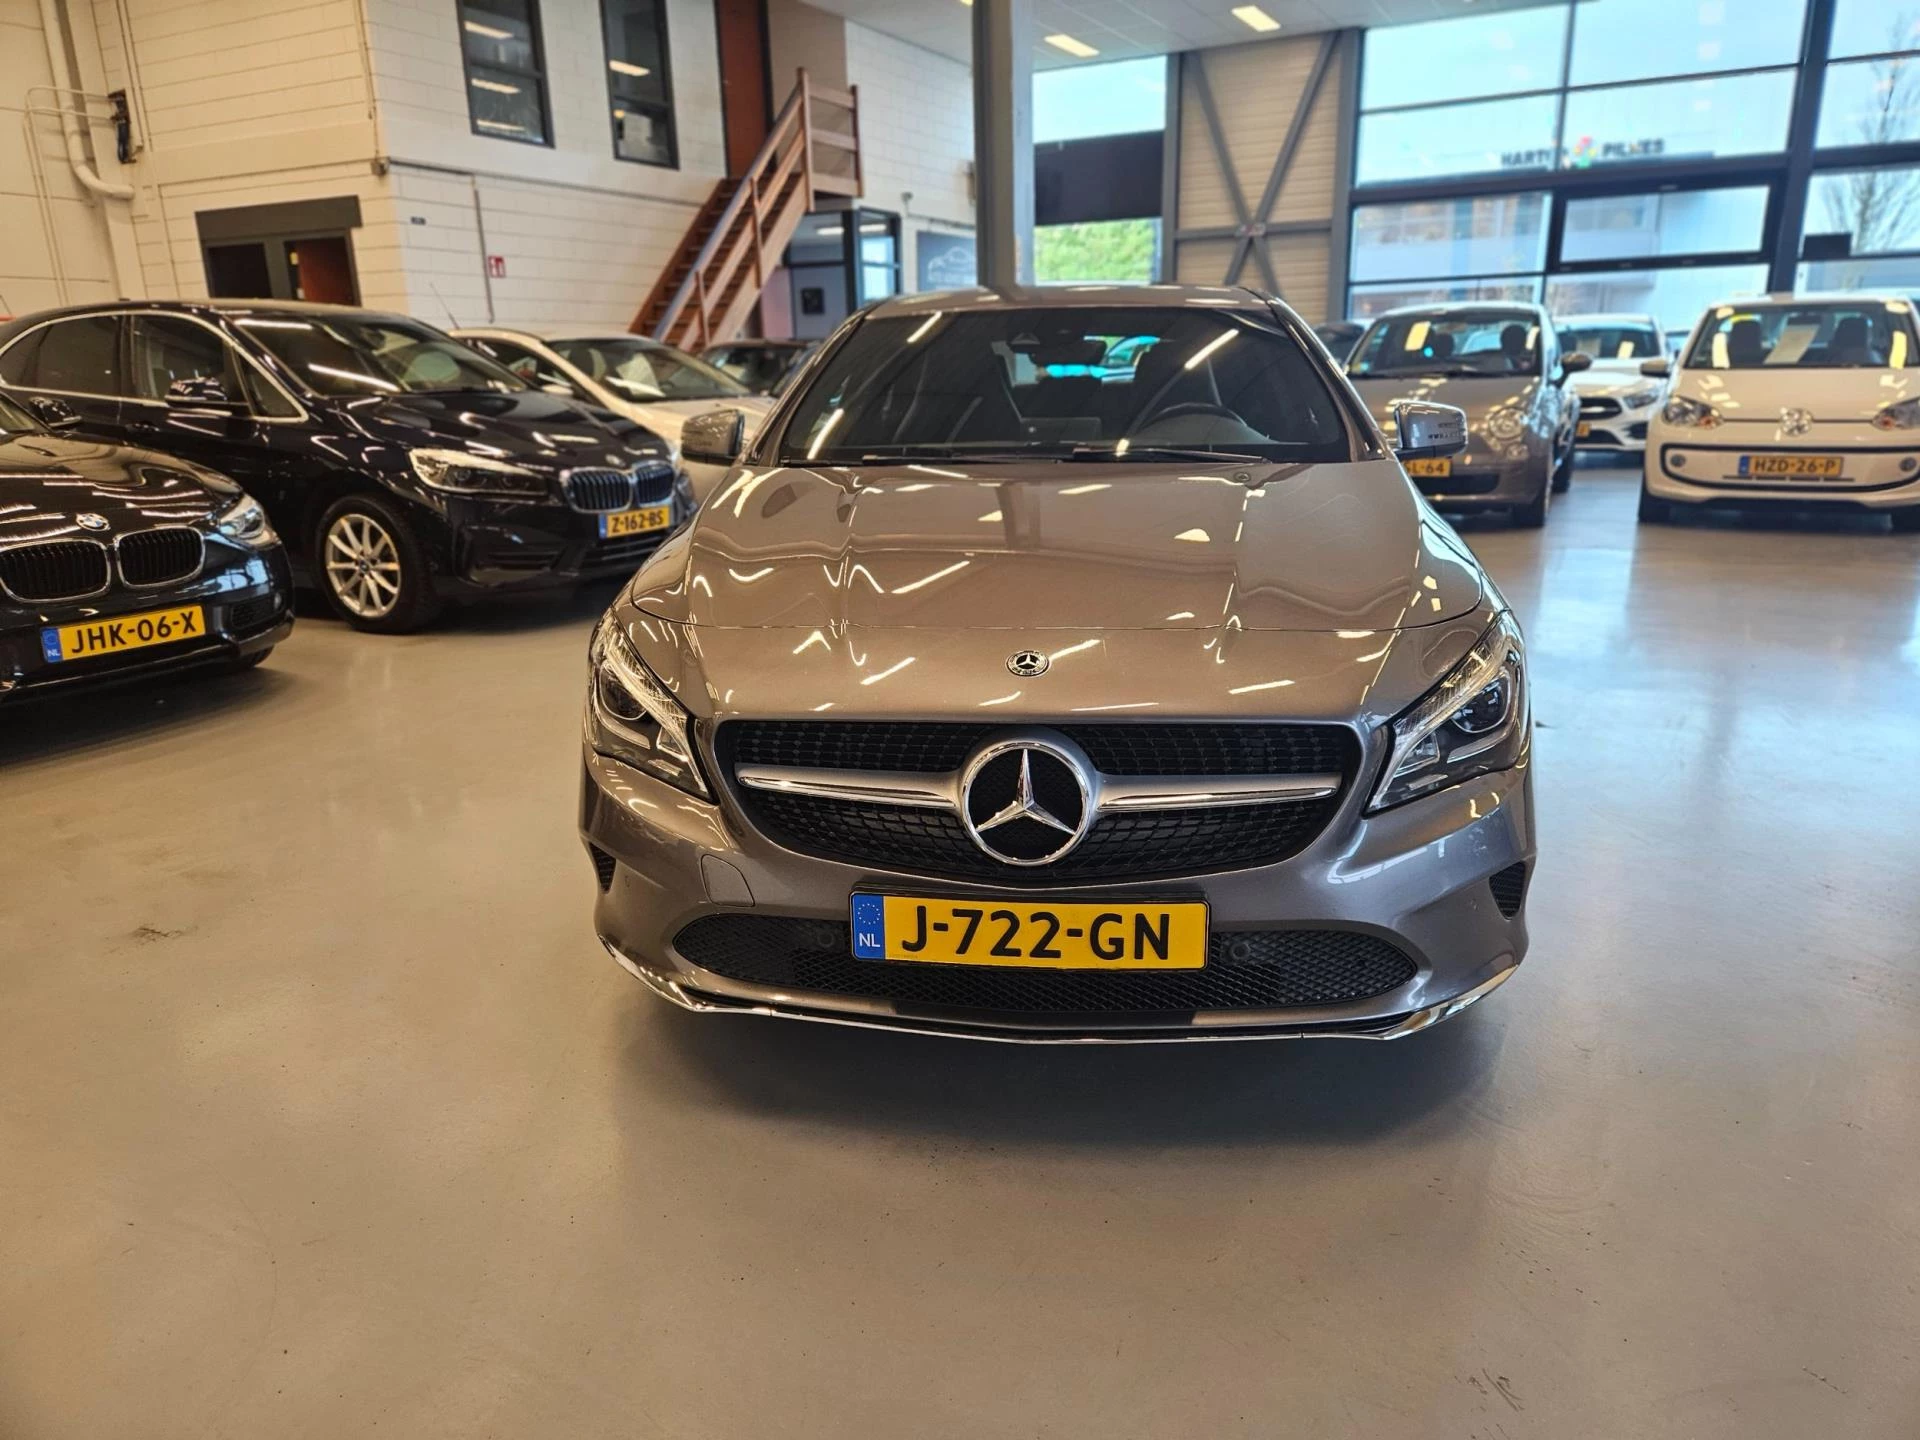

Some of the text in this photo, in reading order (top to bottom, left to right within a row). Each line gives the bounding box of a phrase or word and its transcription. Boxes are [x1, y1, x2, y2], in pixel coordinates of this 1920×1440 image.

[1753, 459, 1837, 474] HZD-26-P
[611, 509, 664, 534] Z-162-BS
[47, 610, 196, 657] NL JHK-06-X
[858, 905, 1171, 961] NL J-722-GN
